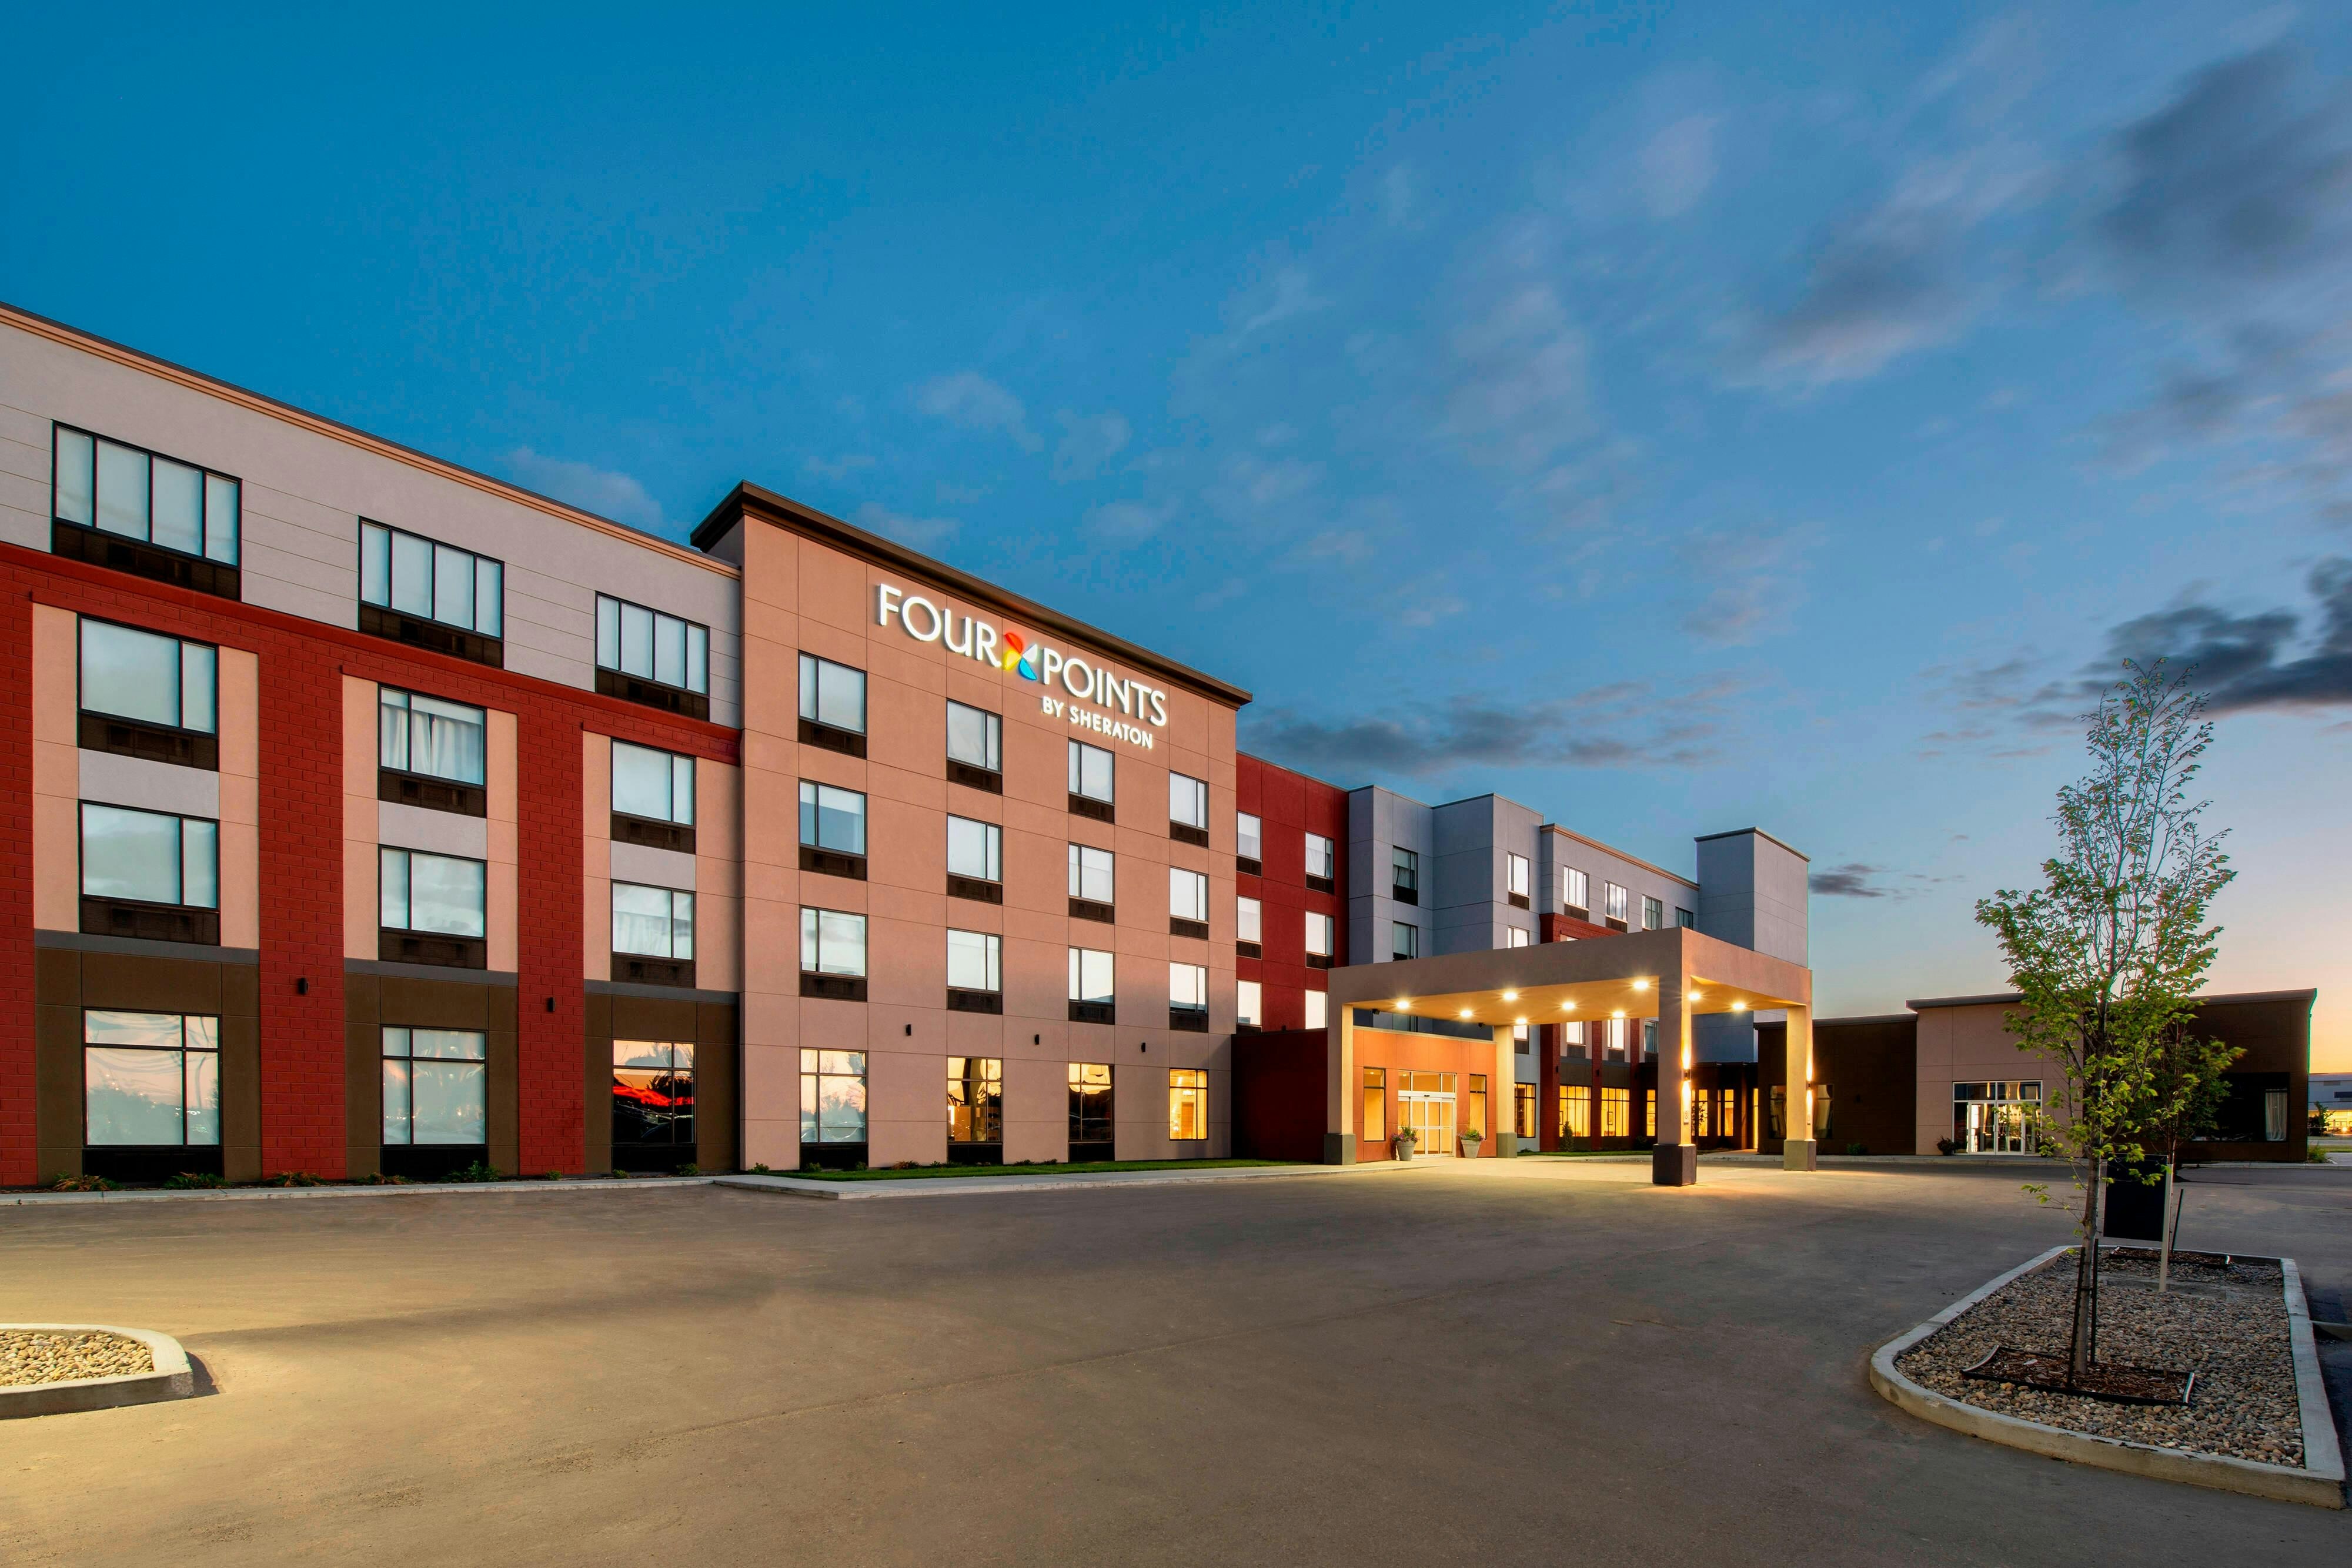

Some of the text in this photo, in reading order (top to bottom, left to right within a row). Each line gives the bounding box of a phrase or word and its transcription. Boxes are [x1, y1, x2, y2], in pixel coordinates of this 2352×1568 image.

[878, 583, 1167, 727] FOUR POINTS
[1042, 696, 1152, 749] BY SHERATON
